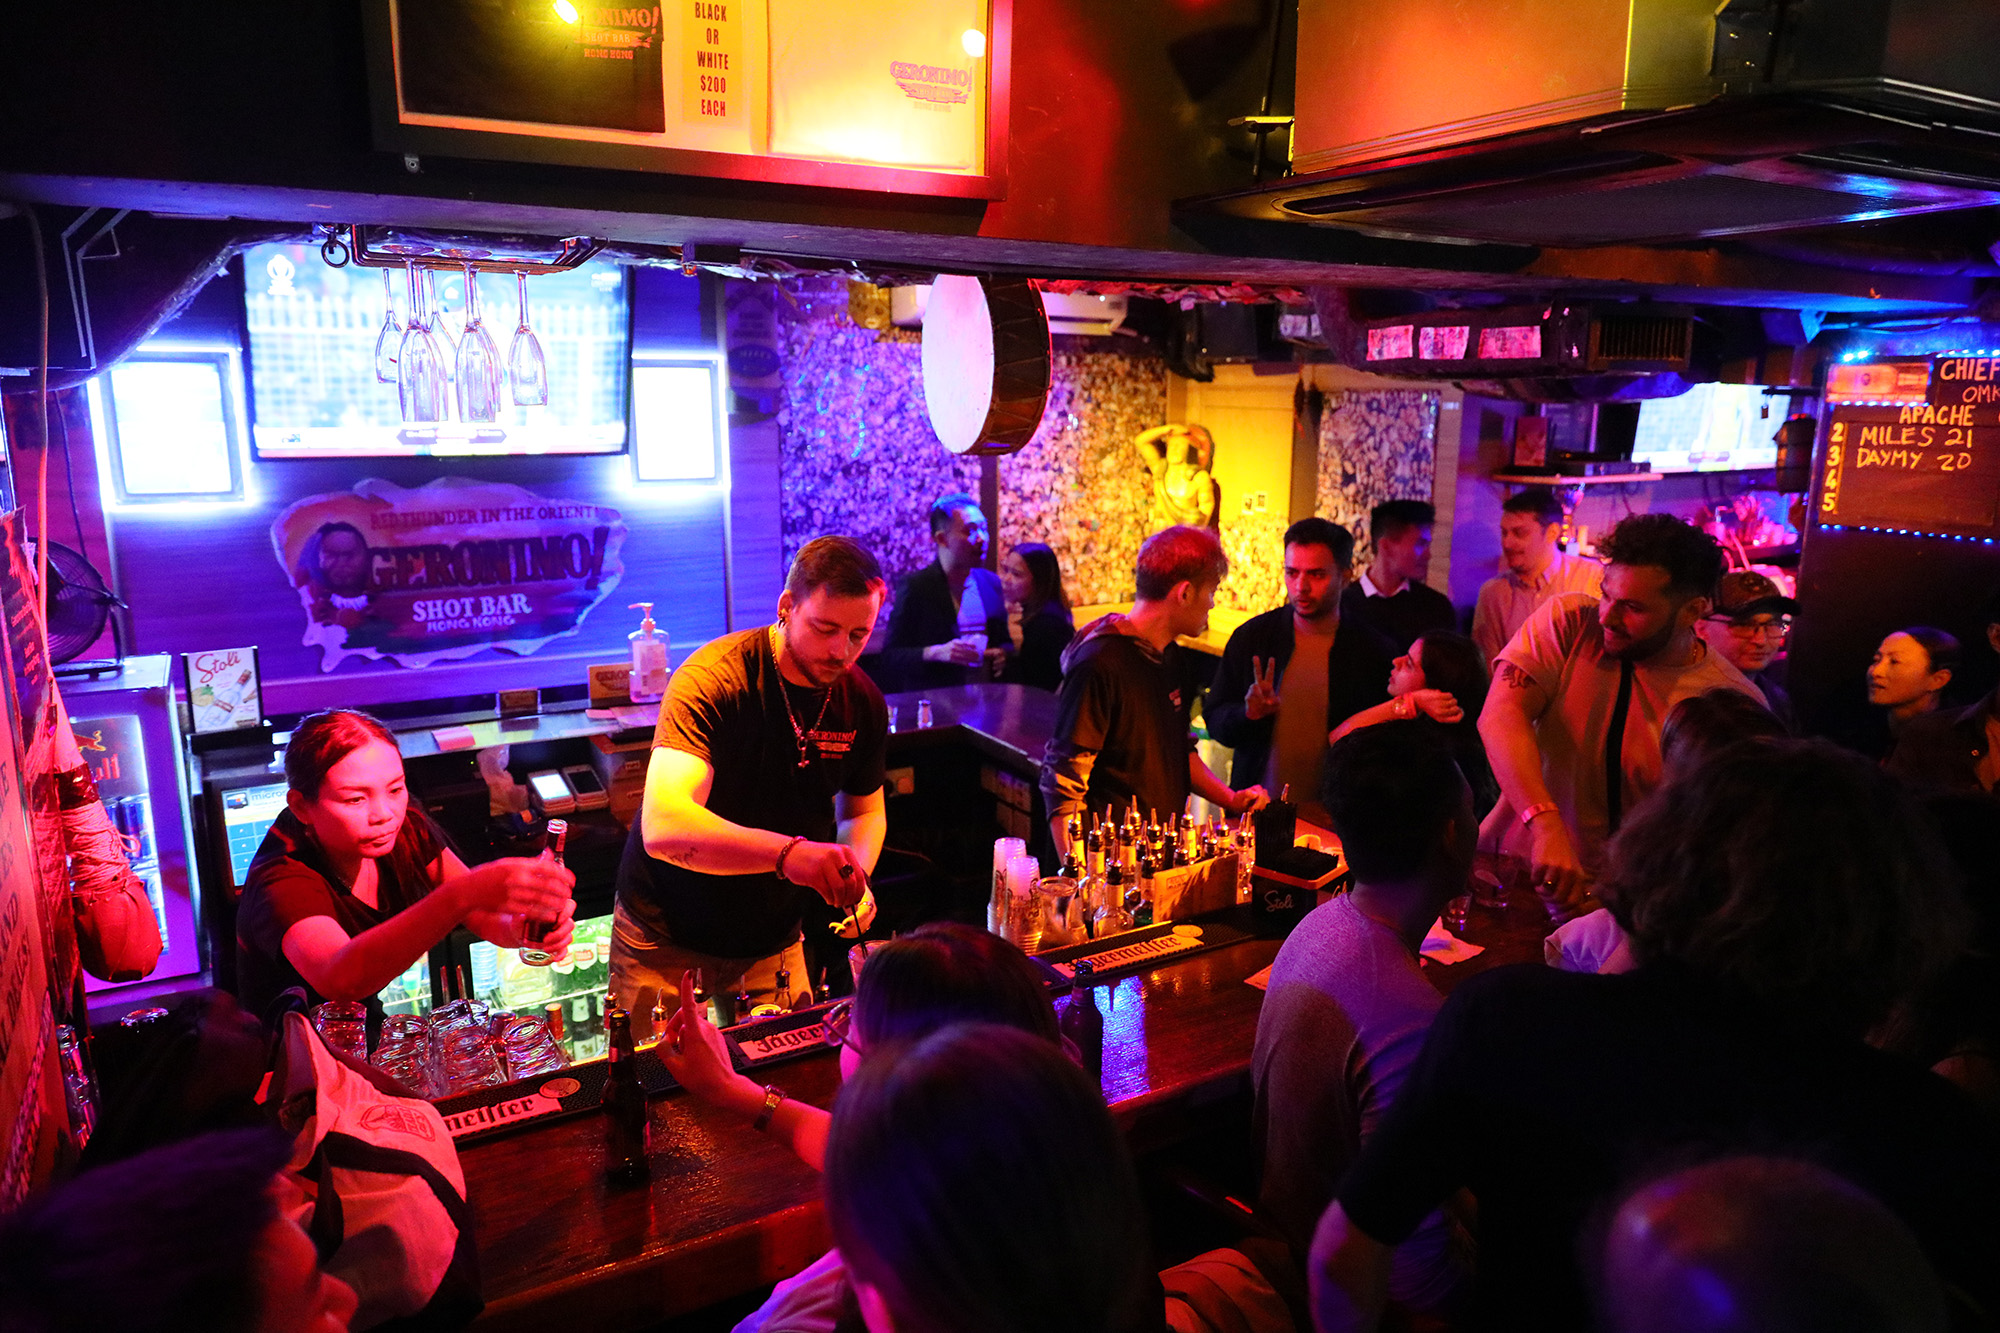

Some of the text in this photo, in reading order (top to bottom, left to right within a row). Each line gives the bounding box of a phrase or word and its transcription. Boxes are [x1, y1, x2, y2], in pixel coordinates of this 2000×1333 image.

[695, 2, 727, 22] BLACK
[612, 34, 631, 43] BAR
[706, 28, 719, 45] OR
[697, 51, 729, 70] WHITE
[700, 75, 726, 93] $200
[890, 60, 973, 92] GERONIMO!
[701, 99, 726, 117] EACH
[1940, 358, 2000, 381] CHIEF
[1899, 404, 1976, 427] APACHE
[1831, 422, 1844, 443] 2
[1860, 425, 1973, 449] MILES 21
[1827, 445, 1841, 467] 3
[1856, 447, 1972, 471] DAYMY 20
[1824, 469, 1838, 490] 4
[1821, 492, 1837, 512] 5
[371, 512, 396, 529] RED
[397, 509, 478, 528] THUNDER
[481, 507, 500, 525] IN
[502, 507, 535, 523] THE
[367, 526, 610, 593] GERONIMO!
[412, 593, 533, 622] SHOT BAR
[426, 614, 516, 633] HONG KONG
[195, 650, 241, 684] Stoli
[808, 729, 857, 744] ERONIMO!
[1264, 890, 1294, 912] Stoli
[1068, 936, 1181, 973] Jgermeister
